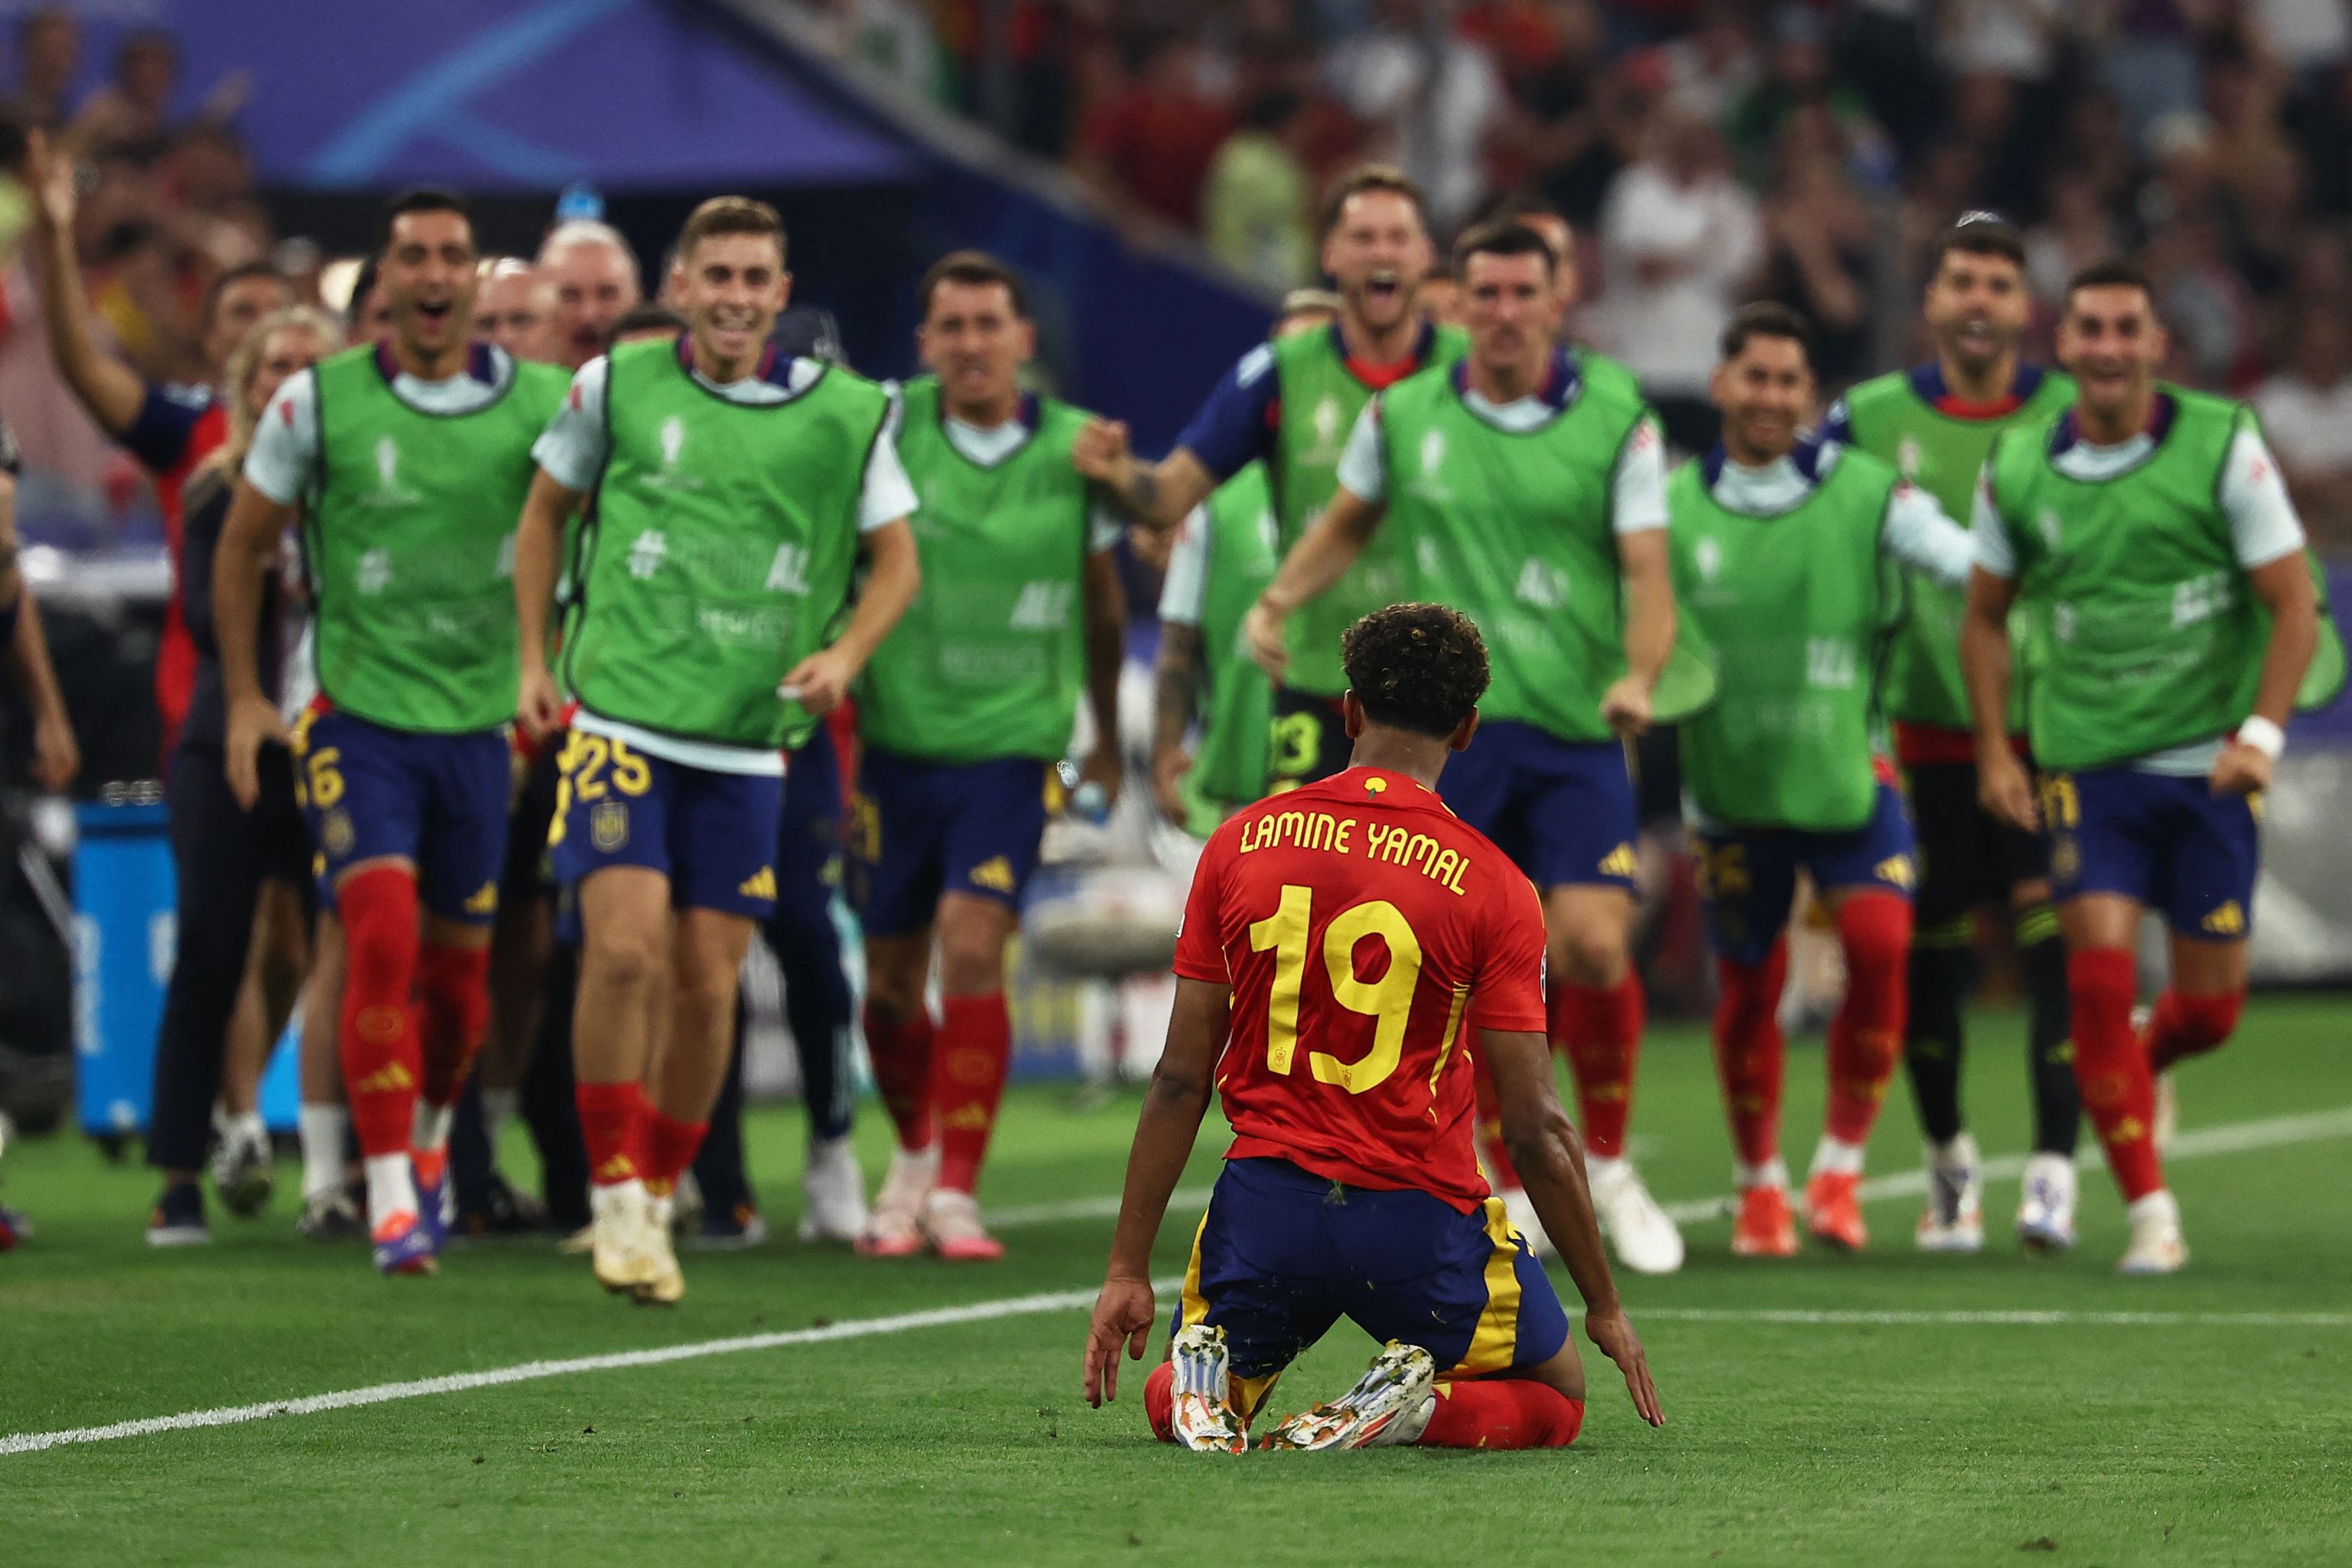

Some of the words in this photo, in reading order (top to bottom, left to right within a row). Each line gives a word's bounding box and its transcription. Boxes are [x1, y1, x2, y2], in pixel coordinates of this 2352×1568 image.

[576, 734, 652, 801] 25
[1240, 811, 1357, 854] LAMINE
[1367, 822, 1469, 896] YAMAL
[1249, 884, 1423, 1095] 19
